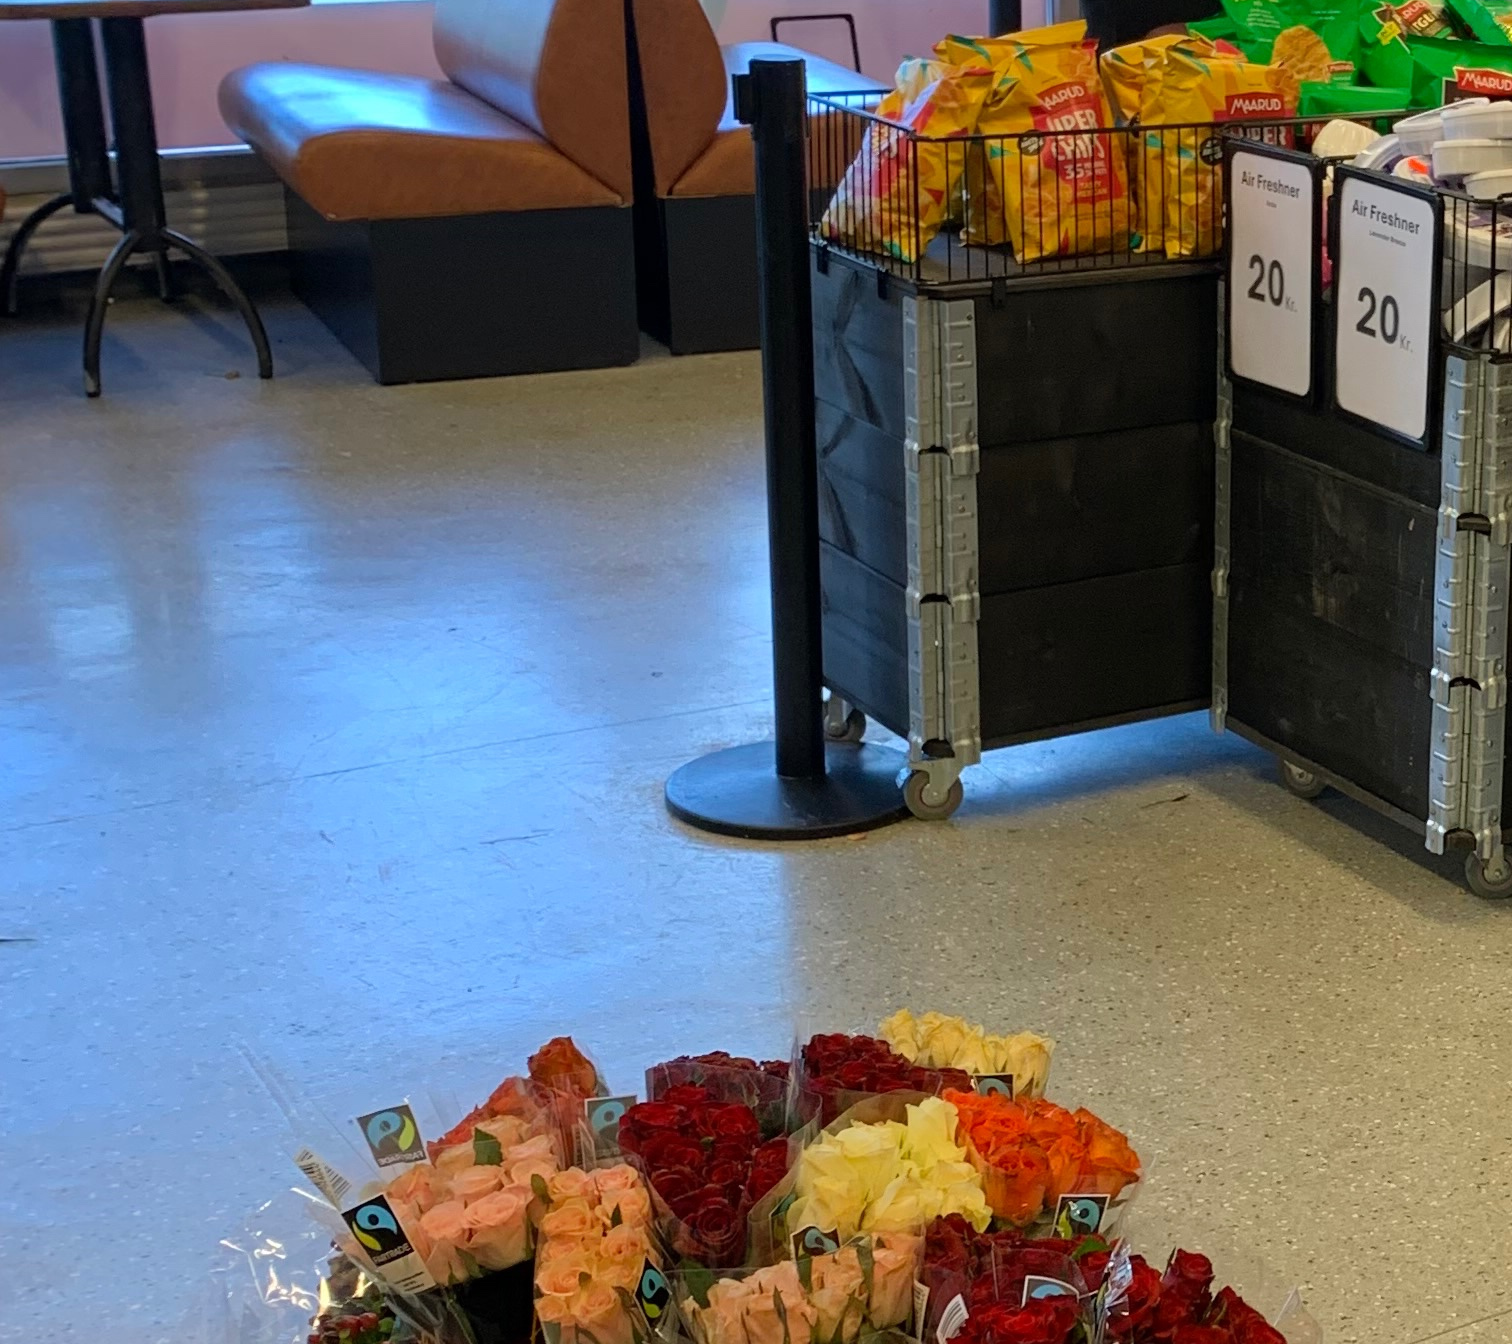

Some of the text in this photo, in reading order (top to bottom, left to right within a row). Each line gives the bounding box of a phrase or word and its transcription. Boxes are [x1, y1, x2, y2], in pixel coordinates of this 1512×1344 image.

[1230, 99, 1282, 115] MAARUD
[1241, 170, 1300, 200] Air Freshner
[1352, 199, 1421, 235] Air Freshner
[1248, 254, 1285, 307] 20
[1356, 286, 1400, 345] 20
